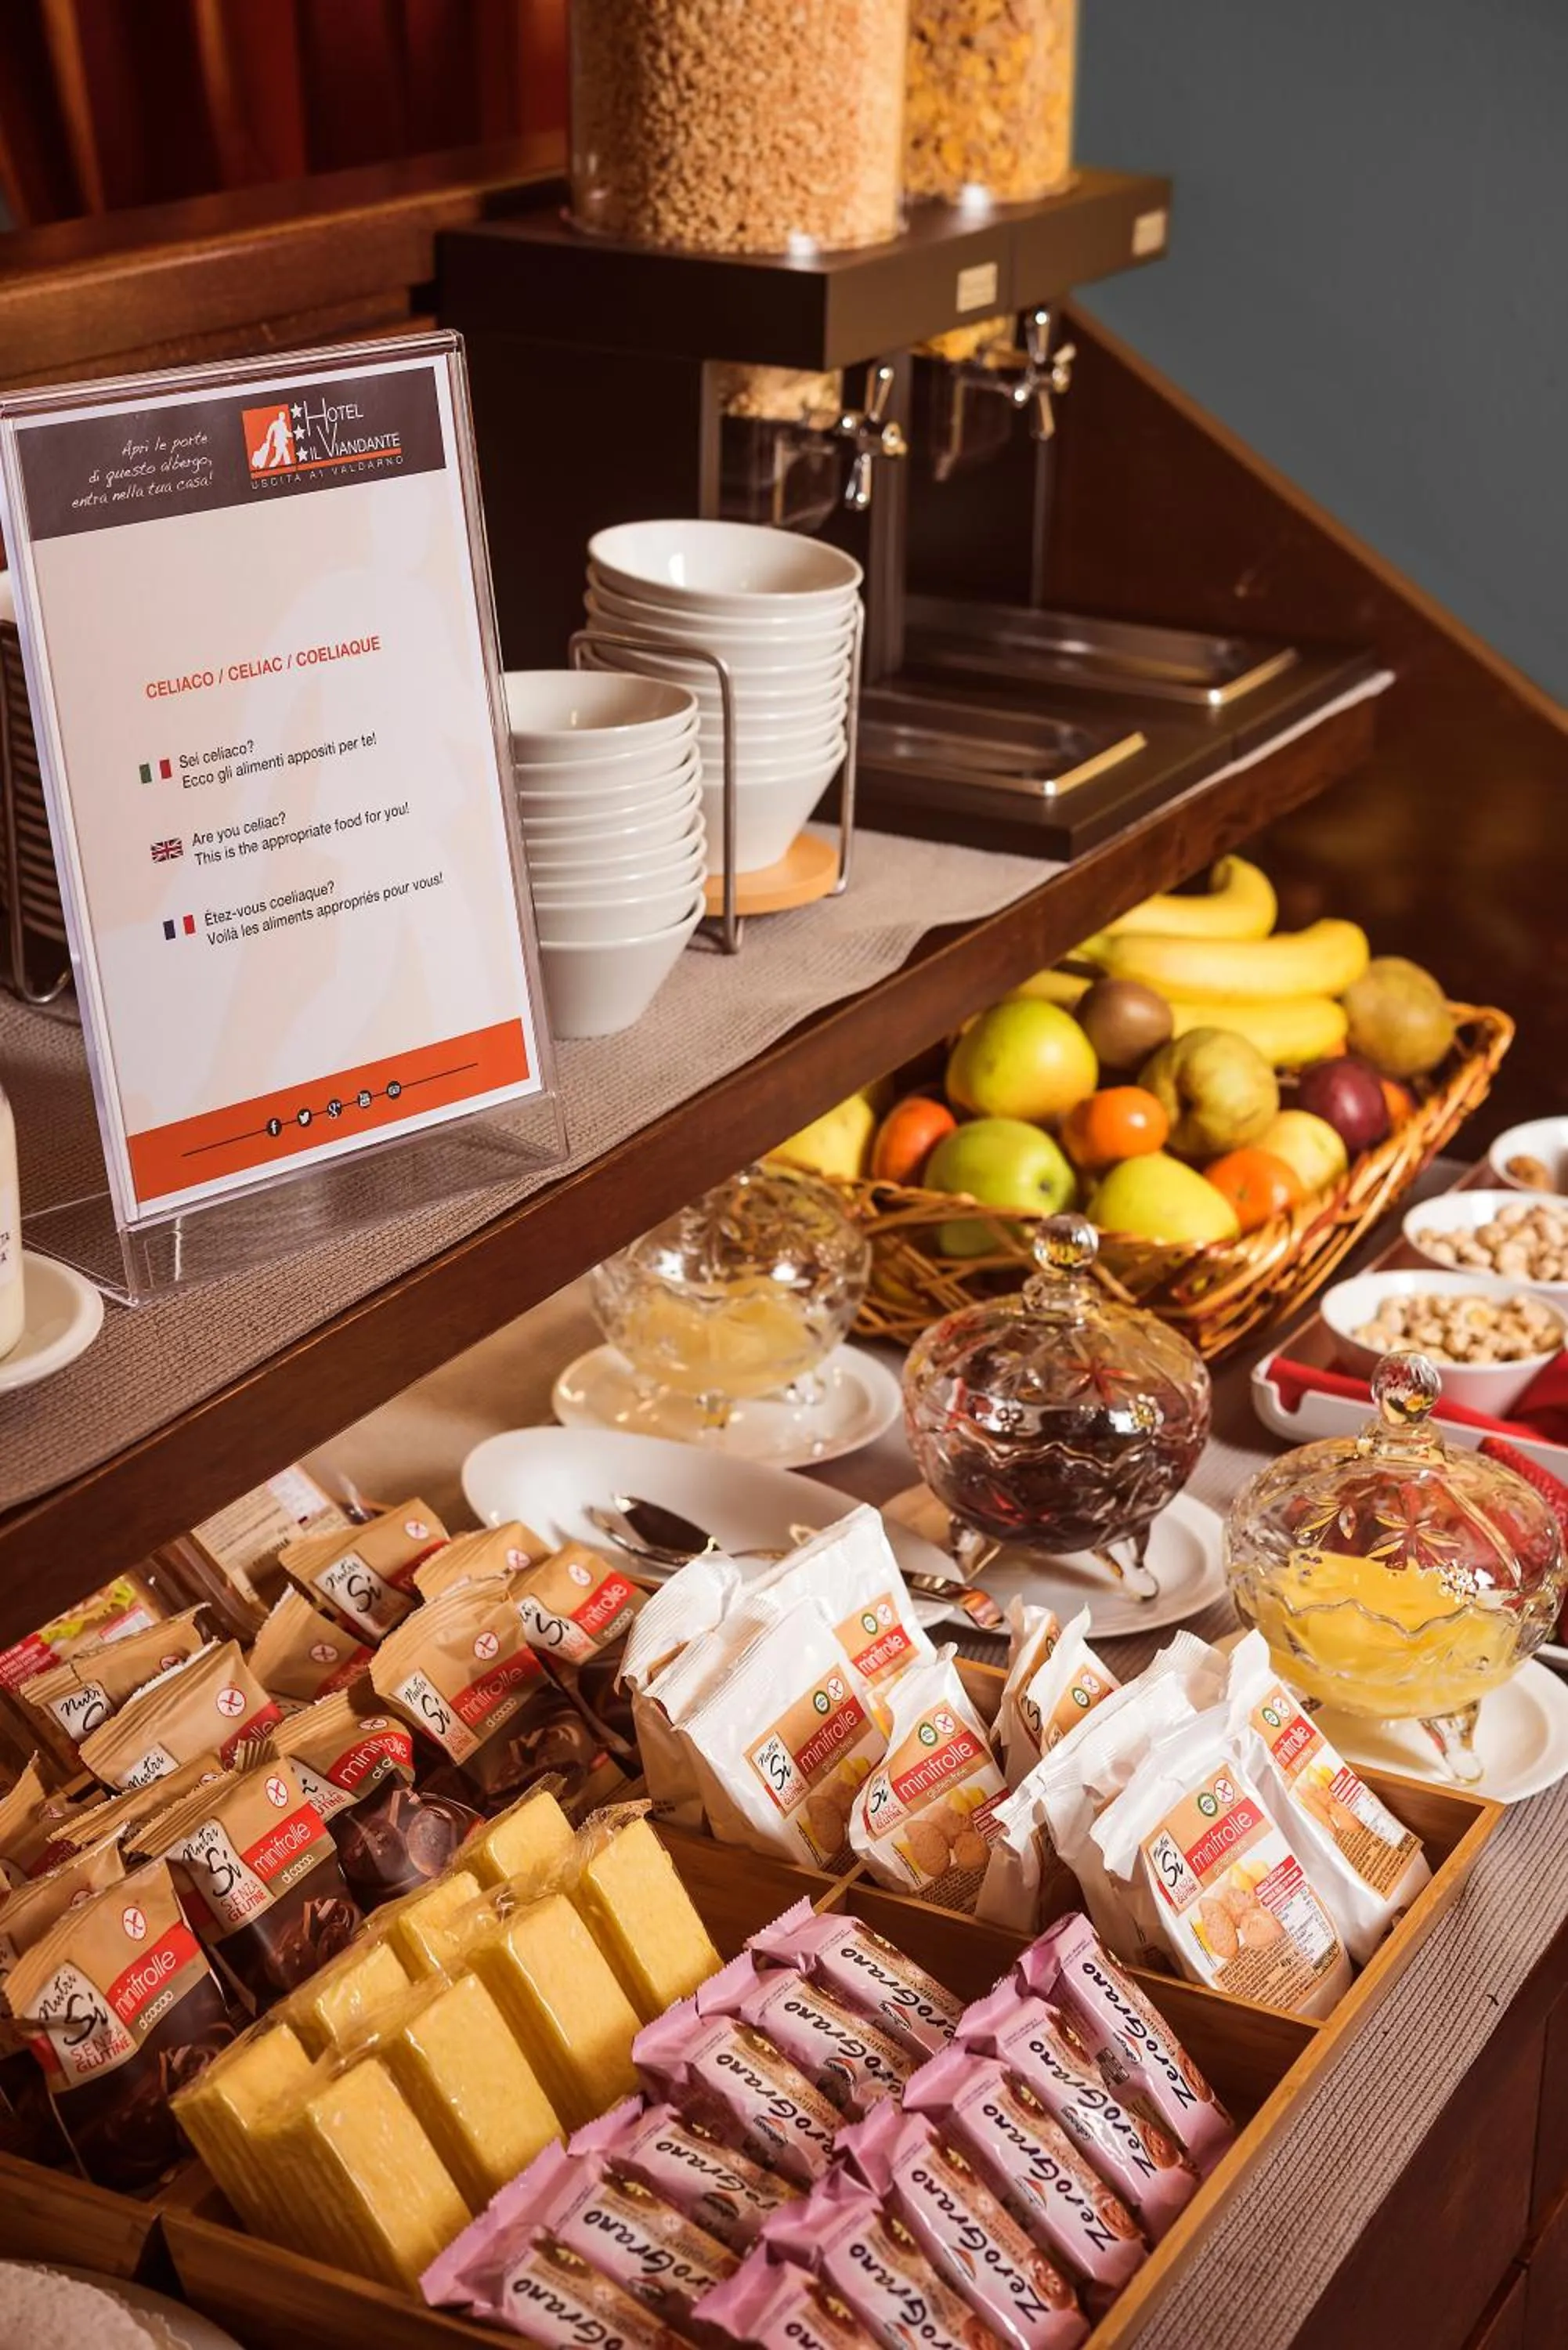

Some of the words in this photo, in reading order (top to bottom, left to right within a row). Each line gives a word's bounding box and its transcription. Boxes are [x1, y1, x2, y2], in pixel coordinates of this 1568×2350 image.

[122, 439, 149, 460] Apri
[154, 436, 167, 451] le
[171, 431, 208, 454] porte
[316, 421, 401, 458] VIANDANTE
[71, 492, 109, 508] entra
[112, 483, 144, 502] nella
[147, 481, 172, 496] tua
[176, 471, 213, 490] casa!
[89, 468, 100, 483] di
[106, 462, 155, 487] questo
[251, 473, 302, 490] USCITA
[331, 455, 404, 475] VALDARNO
[146, 671, 214, 699] CELIACO
[228, 657, 284, 682] CELIAC
[297, 635, 381, 667] COELIAQUE
[179, 752, 199, 769] Sei
[203, 739, 255, 764] celiaco?
[182, 772, 214, 790] Ecco
[219, 767, 233, 784] gli
[236, 754, 284, 776] alimenti
[287, 743, 336, 770] appositi
[339, 739, 358, 755] per
[361, 731, 377, 748] te!
[191, 830, 214, 847] Are
[217, 825, 240, 844] you
[244, 812, 287, 834] celiac?
[194, 848, 222, 866] This
[225, 844, 236, 859] is
[239, 839, 259, 856] the
[262, 823, 331, 851] appropriate
[334, 813, 363, 833] food
[365, 808, 382, 823] for
[384, 801, 410, 822] you!
[207, 928, 239, 946] Voilà
[241, 920, 259, 937] les
[262, 907, 314, 931] aliments
[316, 889, 381, 920] appropriés
[383, 882, 411, 900] pour
[412, 871, 444, 891] vous!
[269, 880, 335, 908] coeliaque?
[459, 1667, 526, 1721] minifrolle
[494, 1697, 517, 1722] cacao
[800, 1709, 859, 1773] minifrolle
[899, 1742, 974, 1800] minifrolle
[254, 1822, 313, 1875] minifrolle
[291, 1853, 315, 1876] cacao
[1191, 1811, 1254, 1872] minifrolle
[220, 1879, 259, 1910] SENZA
[227, 1890, 268, 1924] GLUTINE
[115, 1950, 177, 2019] minifrolle
[146, 1990, 175, 2023] cacao
[840, 1947, 957, 2041] eroGrano
[70, 2026, 124, 2062] SENZA
[76, 2034, 132, 2074] GLUTINE
[784, 2001, 902, 2094] eroGrano
[1082, 1962, 1198, 2110] ZeroGrano
[716, 2053, 835, 2154] eroGrano
[1029, 2041, 1158, 2178] ZeroGrano
[983, 2103, 1120, 2253] ZeroGrano
[912, 2169, 1050, 2323] ZeroGrano
[512, 2278, 624, 2350] oGrano
